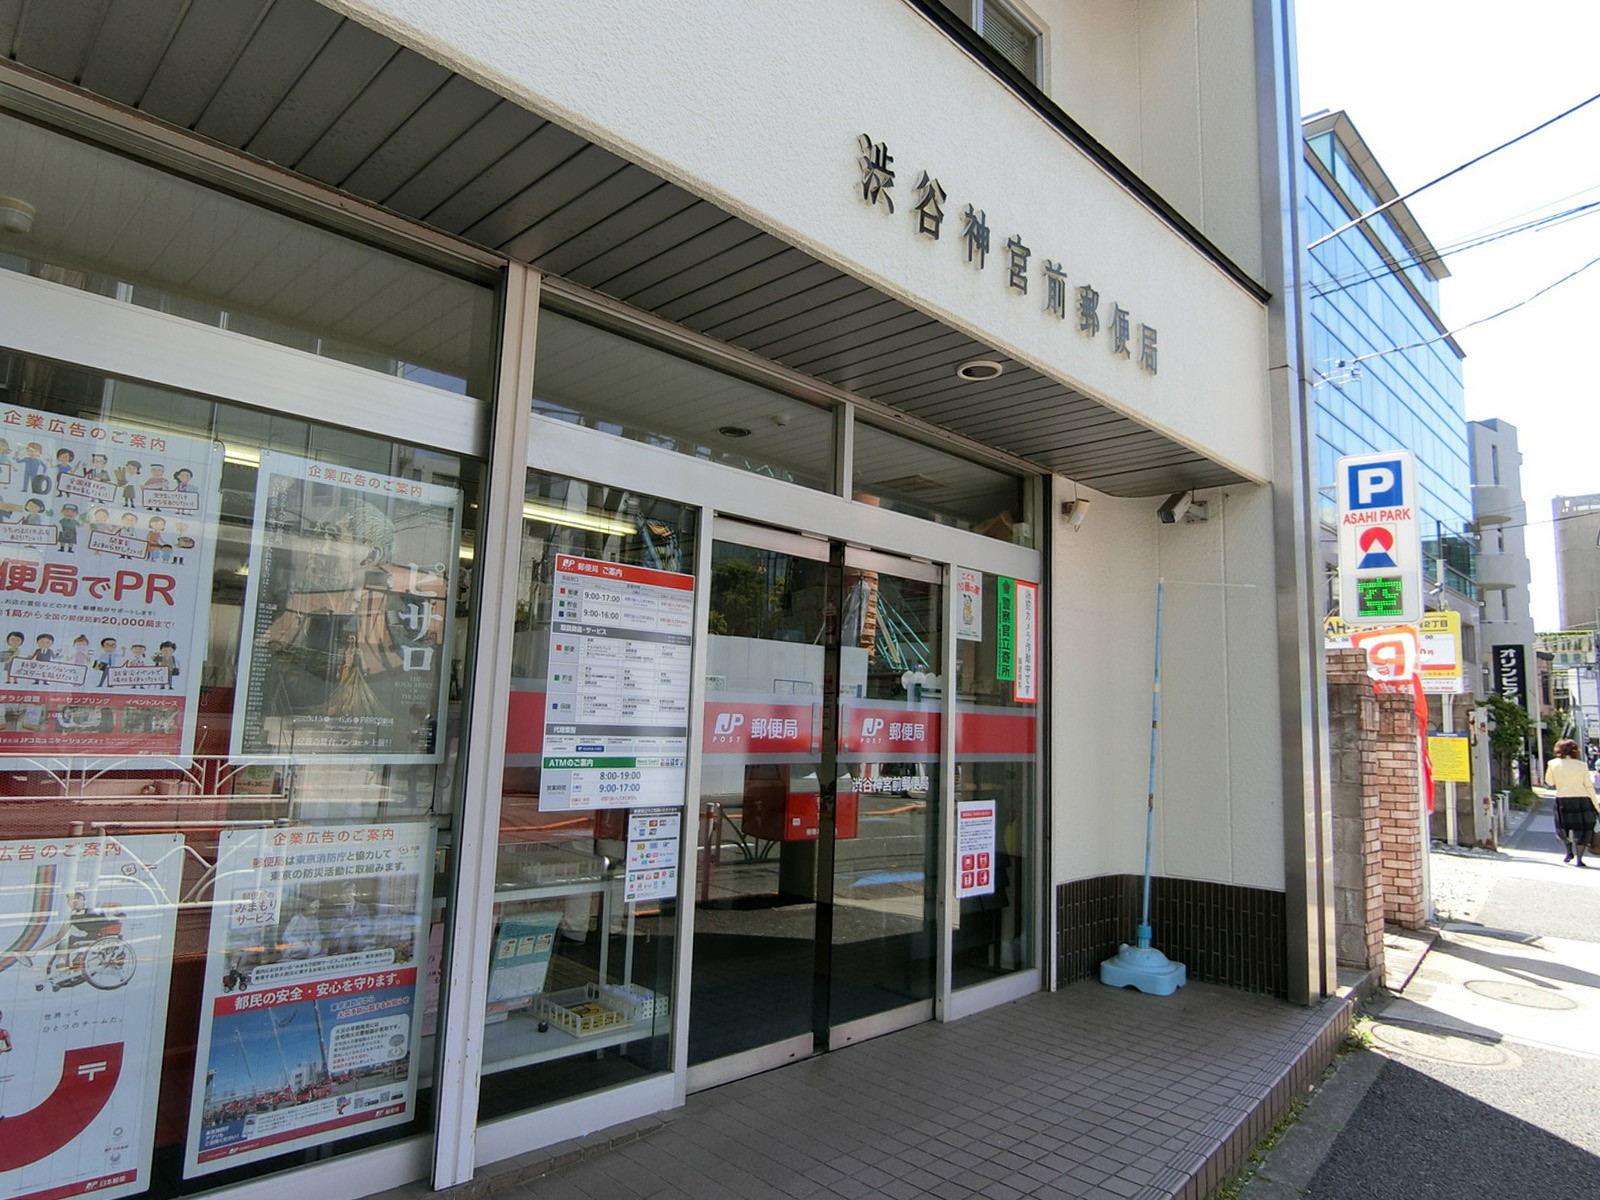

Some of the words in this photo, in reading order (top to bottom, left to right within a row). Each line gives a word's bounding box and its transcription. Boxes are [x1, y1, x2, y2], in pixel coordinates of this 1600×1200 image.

[854, 132, 1158, 376] 渋谷神宮前郵便局
[3, 409, 167, 452] 企業広告のご案内
[308, 463, 423, 497] 企業広告のご案内
[1358, 467, 1395, 505] P
[1343, 511, 1377, 525] ASAHI
[1380, 508, 1411, 521] PARK
[577, 562, 599, 574] 郵便局
[602, 566, 623, 578] ご案内
[0, 557, 176, 606] 便局でPR
[584, 591, 621, 603] 9:00-17:00
[1358, 576, 1404, 617] 空
[399, 562, 446, 672] ピサロ
[583, 608, 620, 620] 9:00-16:00
[751, 717, 798, 740] 郵便局
[889, 722, 925, 742] 郵便局
[549, 758, 594, 768] ATMのご案内
[599, 771, 642, 780] 8:00-19:00
[852, 775, 930, 793] 渋谷神宮前郵便局
[598, 783, 641, 793] 9:00-17:00
[273, 828, 395, 847] 企業広告のご案内
[0, 842, 122, 862] 広告のご案内
[252, 849, 392, 869] 郵便局は東京消防庁と協力して
[270, 862, 406, 882] 東京の防災活動に取組みます。
[234, 899, 277, 913] みまもり
[236, 912, 276, 925] サービス
[234, 972, 401, 1011] 都民の安全・安心を守ります。
[42, 1016, 123, 1033] ひとつのチームだ。
[44, 1009, 80, 1021] 世界って
